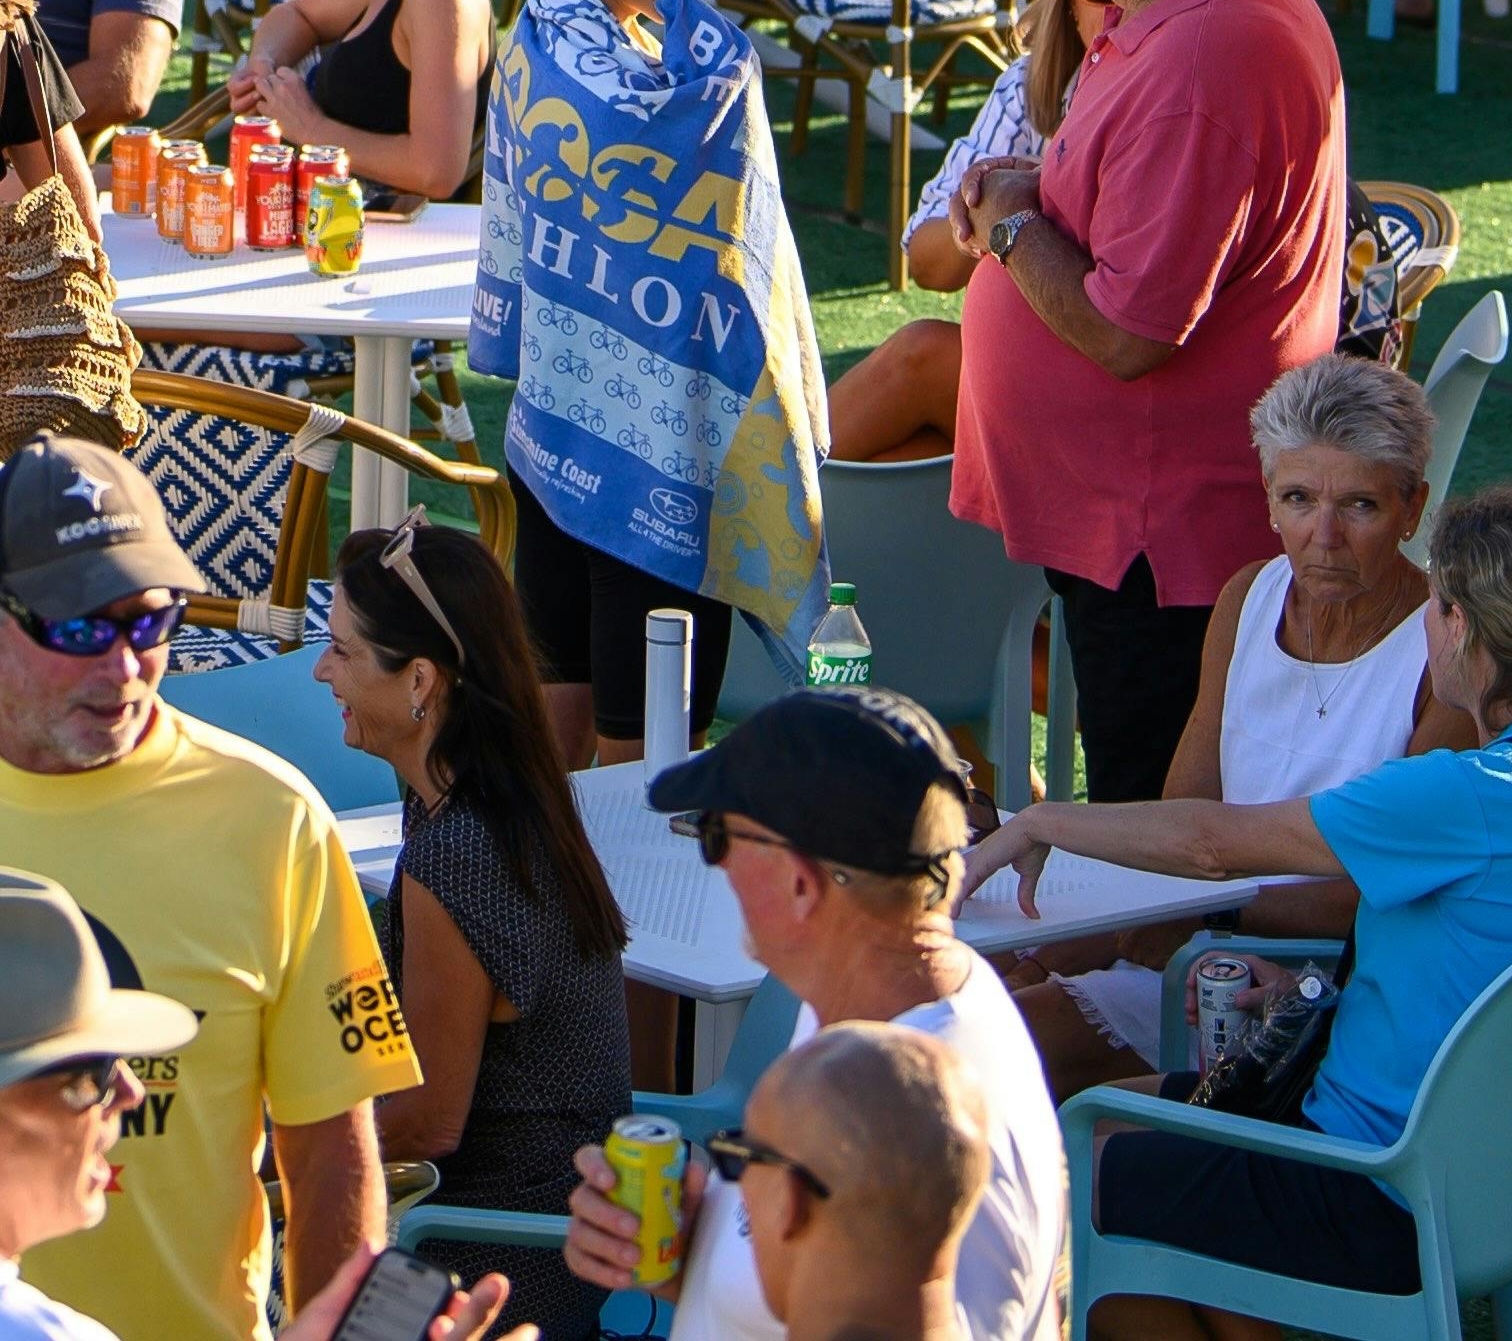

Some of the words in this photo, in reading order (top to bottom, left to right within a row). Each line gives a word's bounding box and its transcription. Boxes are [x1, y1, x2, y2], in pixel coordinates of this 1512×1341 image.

[560, 457, 603, 495] Coast
[631, 507, 701, 548] SUBARU
[808, 657, 870, 685] Sprite
[131, 1055, 179, 1081] ers
[121, 1092, 176, 1138] NY
